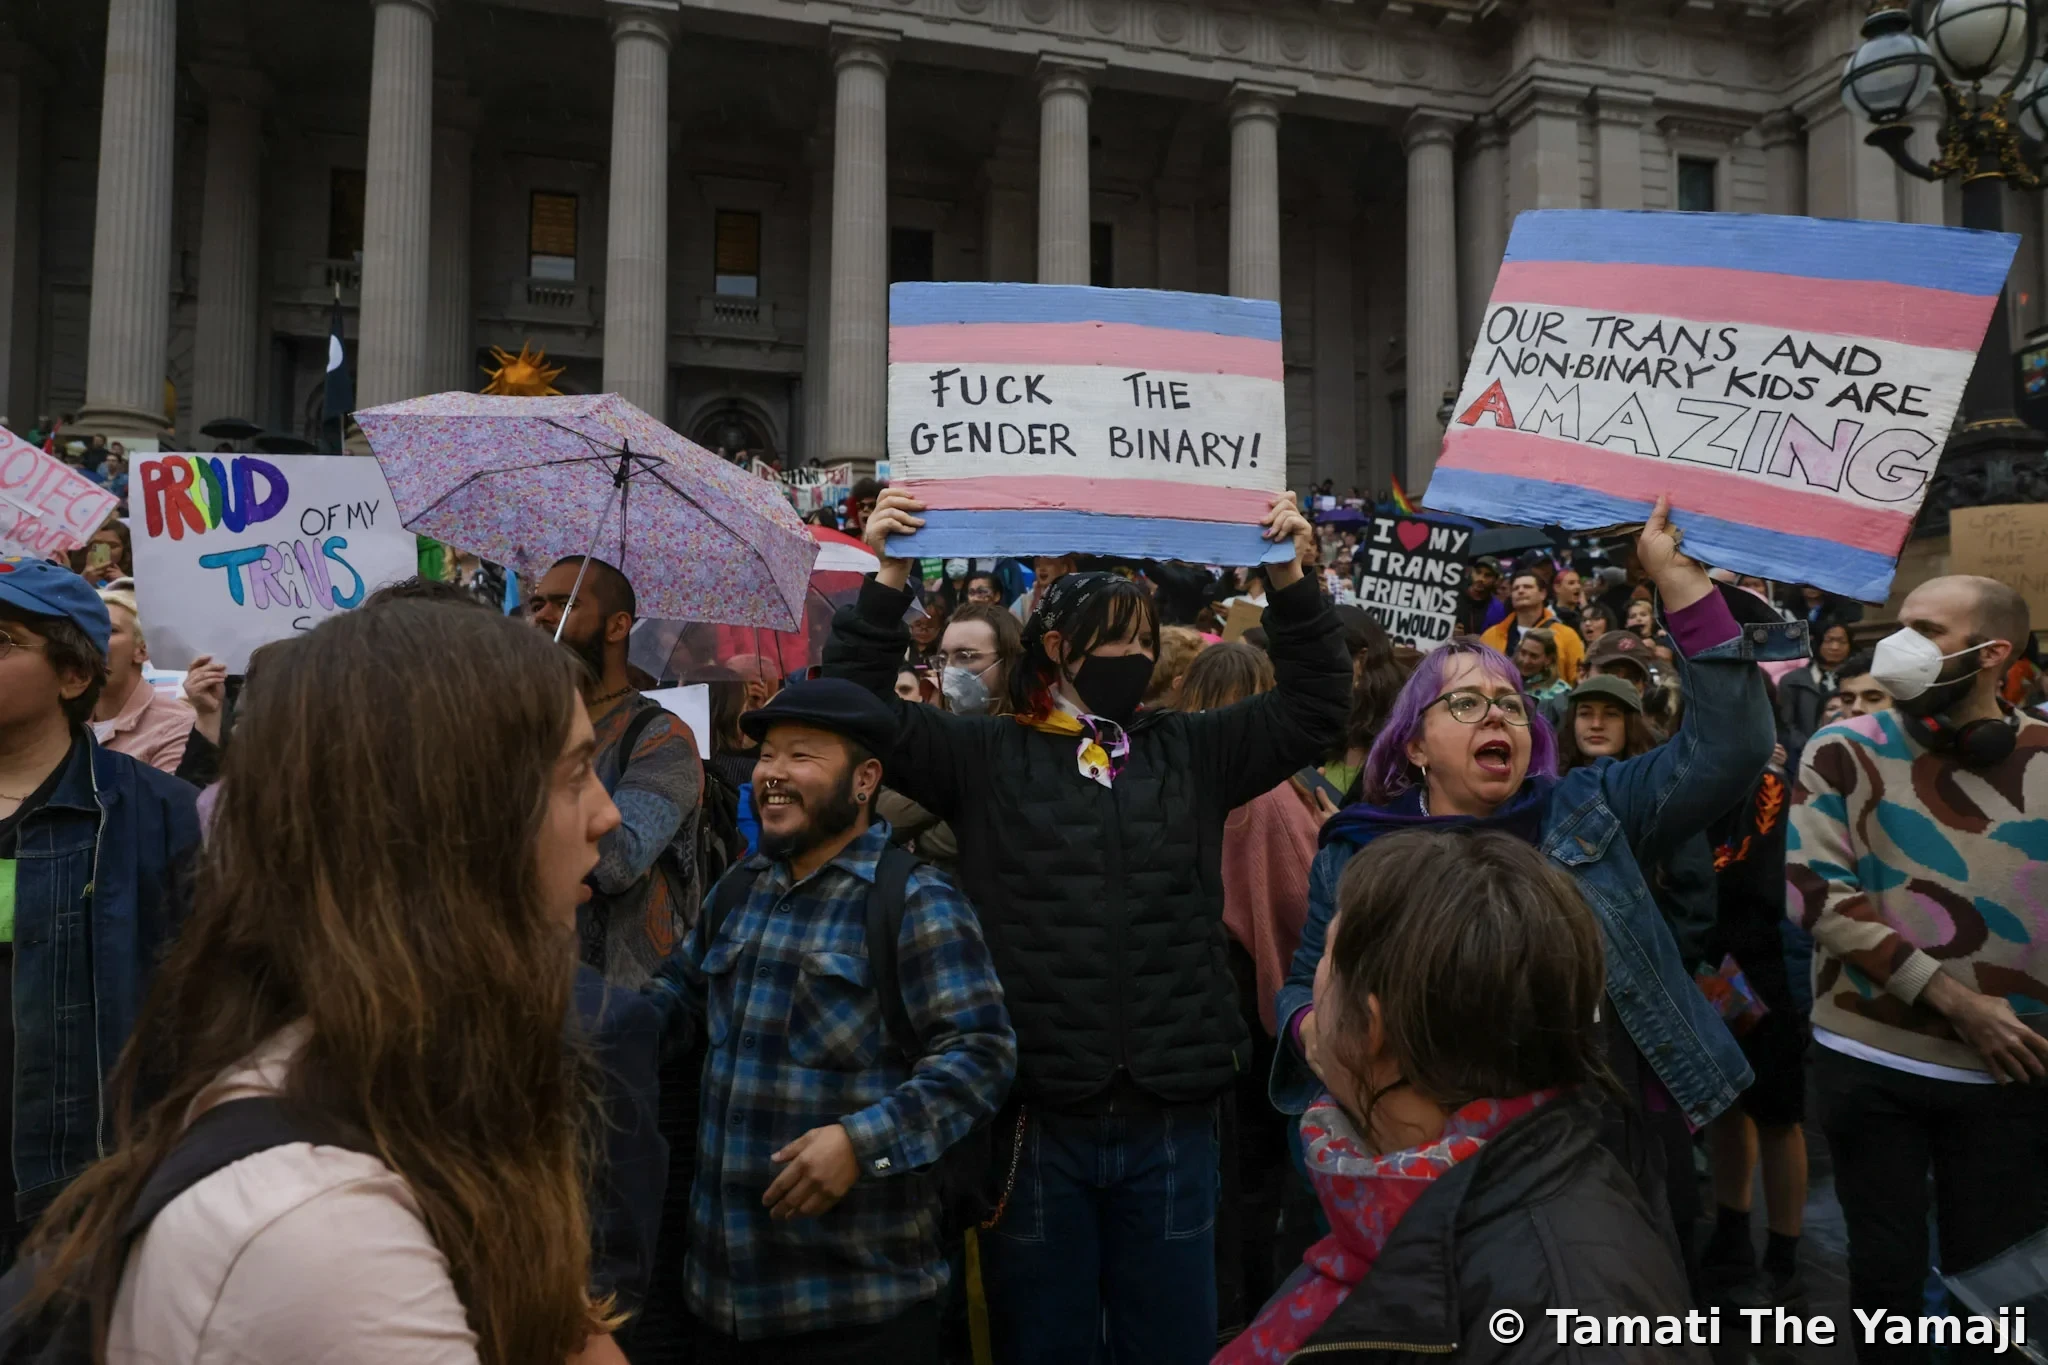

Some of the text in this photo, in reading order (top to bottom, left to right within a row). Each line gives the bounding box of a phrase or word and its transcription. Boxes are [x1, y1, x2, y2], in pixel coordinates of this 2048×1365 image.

[1486, 306, 1882, 376] OUR TRANS AND
[929, 367, 1191, 409] FUCK THE
[1724, 366, 1820, 401] KIDS
[1825, 381, 1932, 418] ARE
[910, 421, 1261, 469] GENDER BINARY!
[1458, 377, 1938, 502] AMAZING
[139, 455, 290, 541] PROUD
[300, 499, 380, 536] OF MY
[1373, 518, 1469, 554] I MY
[198, 535, 365, 611] TRANS
[1368, 549, 1464, 586] TRANS
[1360, 575, 1459, 614] FRIENDS
[1396, 611, 1452, 642] WOULD
